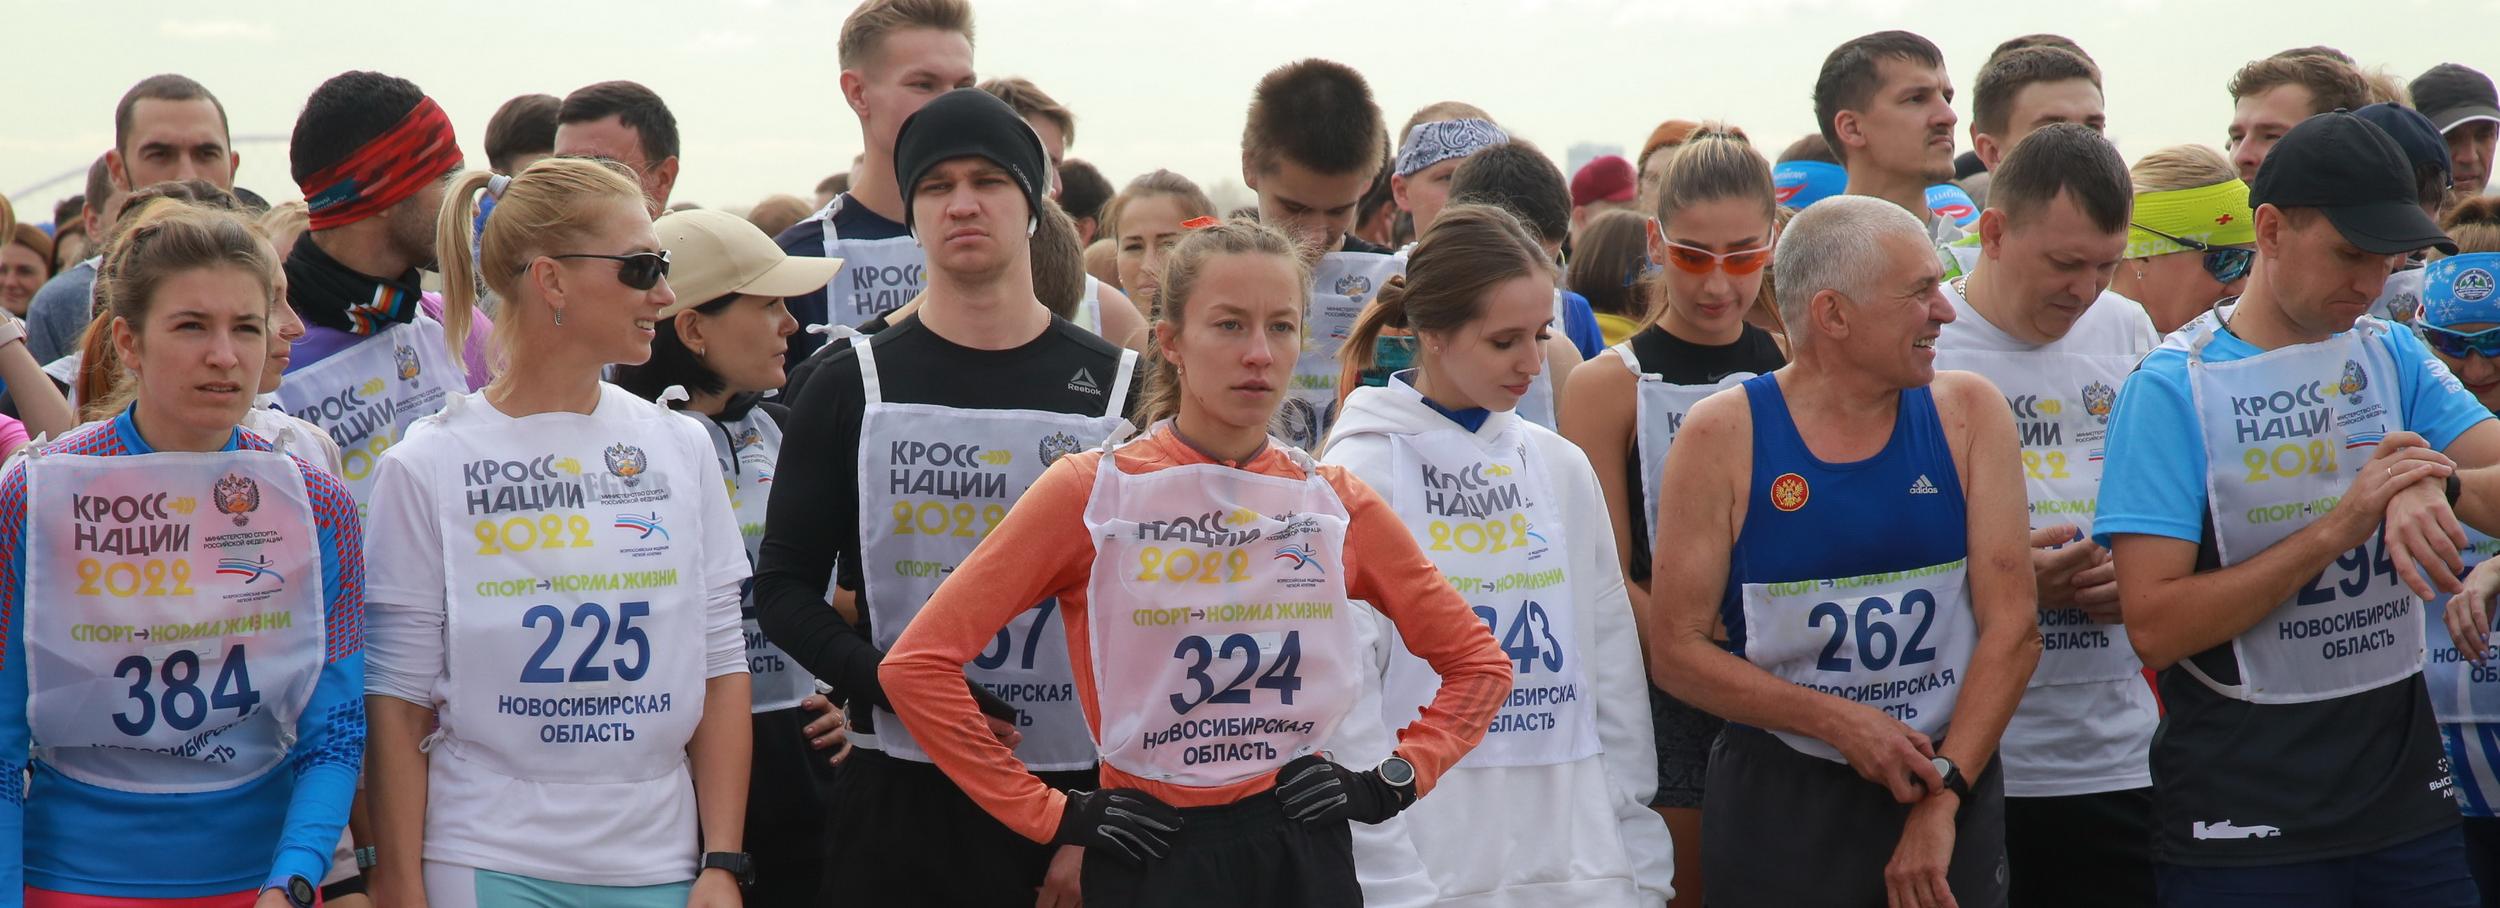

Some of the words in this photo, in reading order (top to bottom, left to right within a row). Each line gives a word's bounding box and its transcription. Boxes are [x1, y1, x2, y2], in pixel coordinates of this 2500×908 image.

[1068, 382, 1102, 396] Reebok
[2231, 380, 2325, 417] КРОСС
[329, 397, 397, 448] АЦИИ
[463, 454, 558, 487] КРОСС
[890, 441, 980, 468] КРОСС
[466, 482, 585, 515] НАЦИИ
[890, 470, 1007, 499] НАЦИИ
[1909, 486, 1938, 494] adidas
[73, 492, 168, 523] КРОСС
[2247, 502, 2304, 524] СПОРТ
[75, 524, 190, 557] НАЦИИ
[203, 540, 245, 549] РОССИЙСКОЙ
[246, 536, 283, 546] ФЕДЕРАЦИИ
[204, 532, 252, 541] МИНИСТЕРСТВО
[254, 530, 278, 538] СПОРТА
[474, 513, 594, 555] 2022
[1428, 512, 1528, 554] 2022
[75, 557, 195, 597] 2022
[895, 560, 942, 578] СПОРТ
[1137, 546, 1252, 583] 2022
[476, 578, 536, 597] СПОРТ
[550, 572, 620, 594] НОРМА
[622, 567, 678, 590] ЖИЗНИ
[71, 622, 133, 643] СПОРТ
[151, 618, 223, 642] НОРМА
[224, 610, 293, 636] ЖИЗНИ
[1133, 606, 1191, 627] СПОРТ
[1206, 603, 1273, 623] НОРМА
[1276, 601, 1334, 621] ЖИЗНИ
[520, 601, 650, 683] 225
[1807, 588, 1937, 673] 262
[2322, 628, 2396, 660] ОБЛАСТЬ
[1169, 630, 1302, 715] 324
[112, 643, 260, 737] 384
[498, 692, 671, 717] НОВОСИБИРСКАЯ
[540, 723, 635, 744] ОБЛАСТЬ
[1143, 717, 1315, 750] НОВОСИБИРСКАЯ
[1183, 741, 1277, 766] ОБЛАСТЬ
